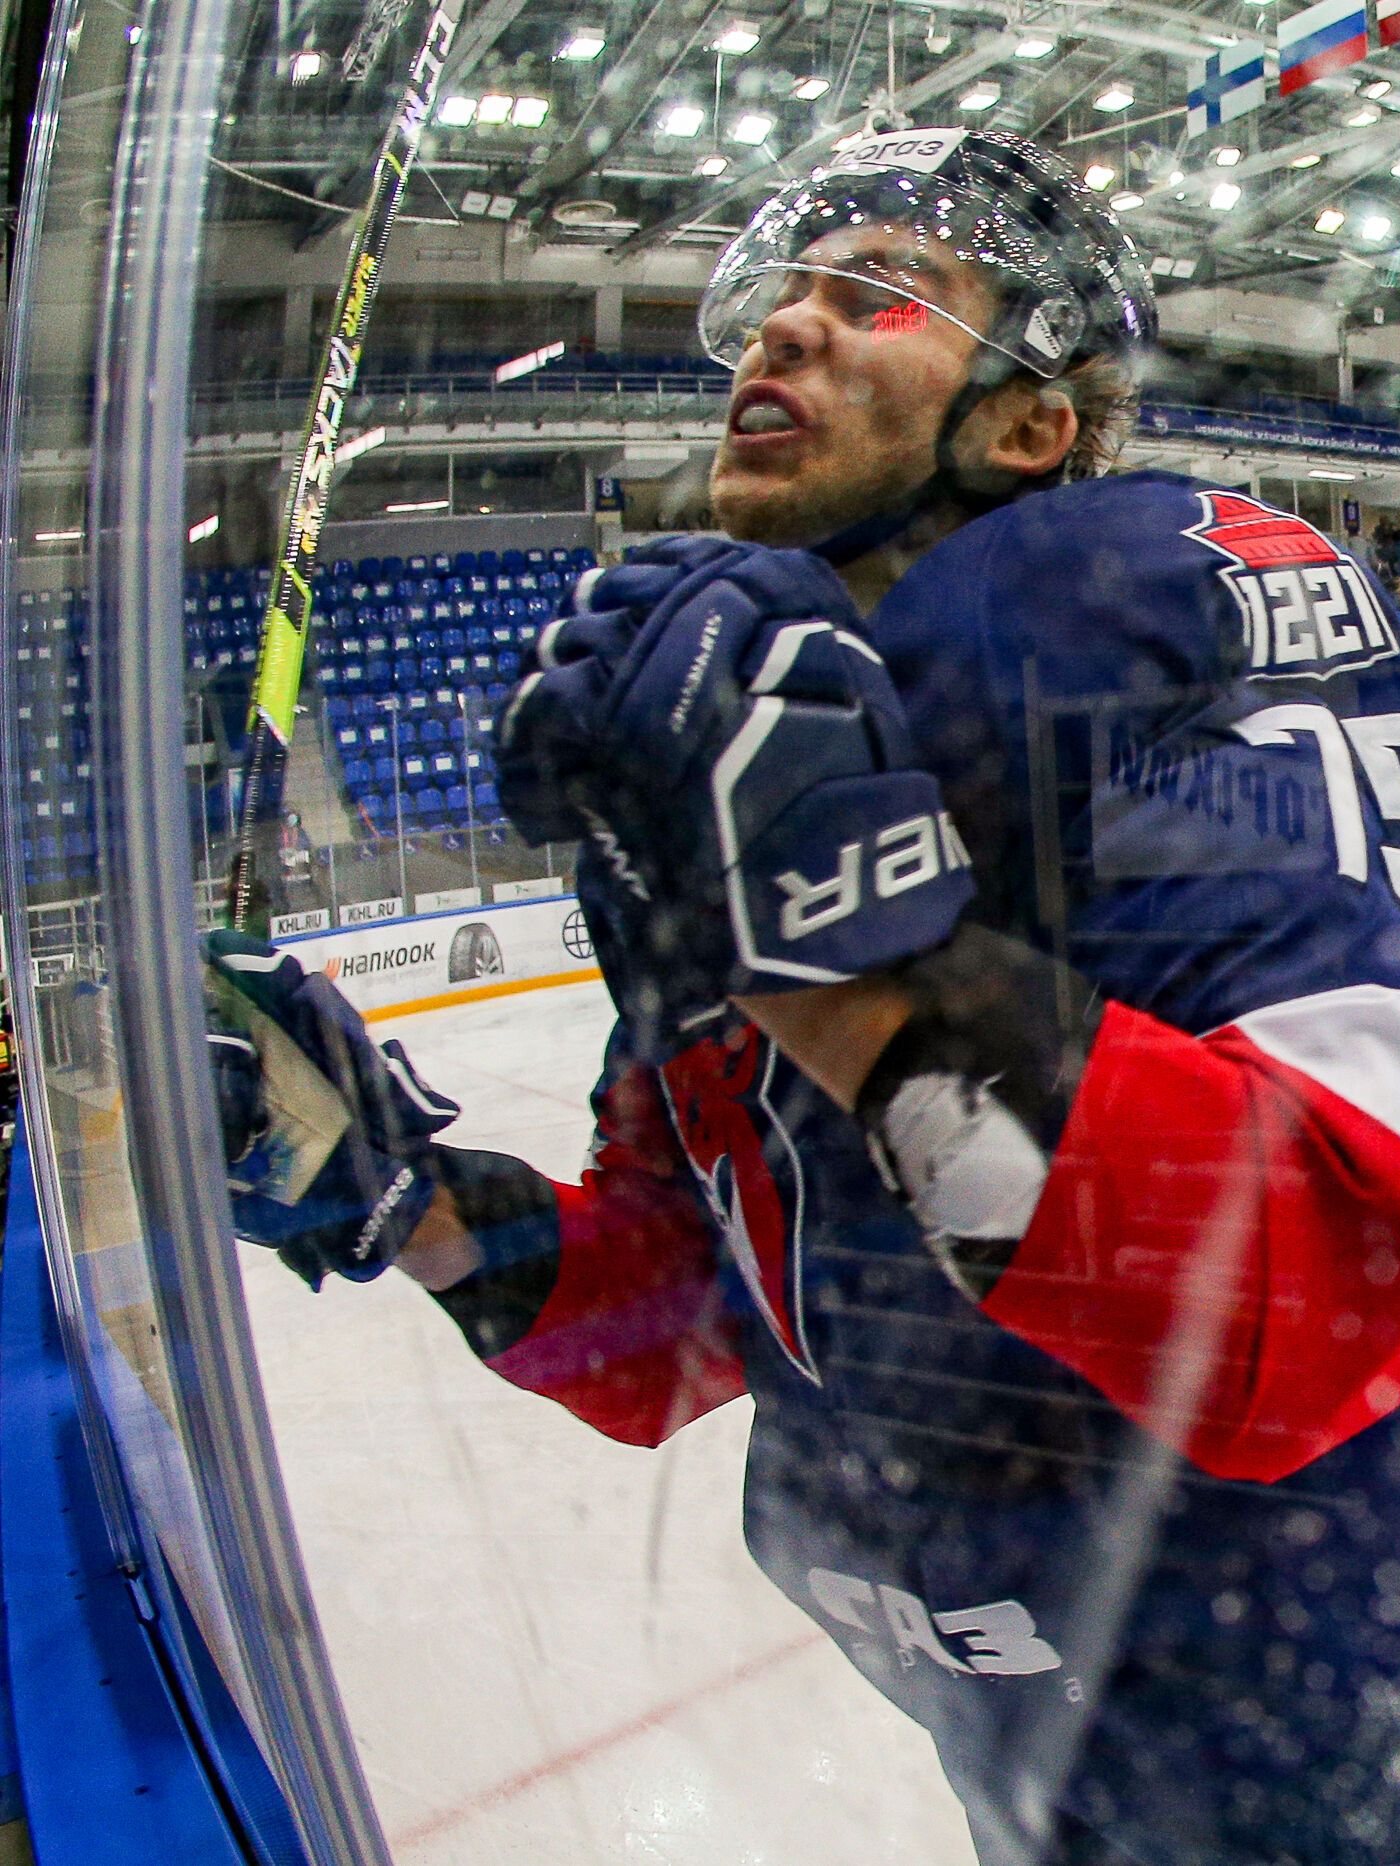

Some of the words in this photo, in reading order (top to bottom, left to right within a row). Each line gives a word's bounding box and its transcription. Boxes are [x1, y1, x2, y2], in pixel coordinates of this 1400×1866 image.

[396, 9, 458, 135] CCM
[302, 336, 361, 488] TACKS
[1236, 564, 1386, 668] 1221
[277, 914, 323, 935] KHL.RU
[348, 902, 396, 922] KHL.RU
